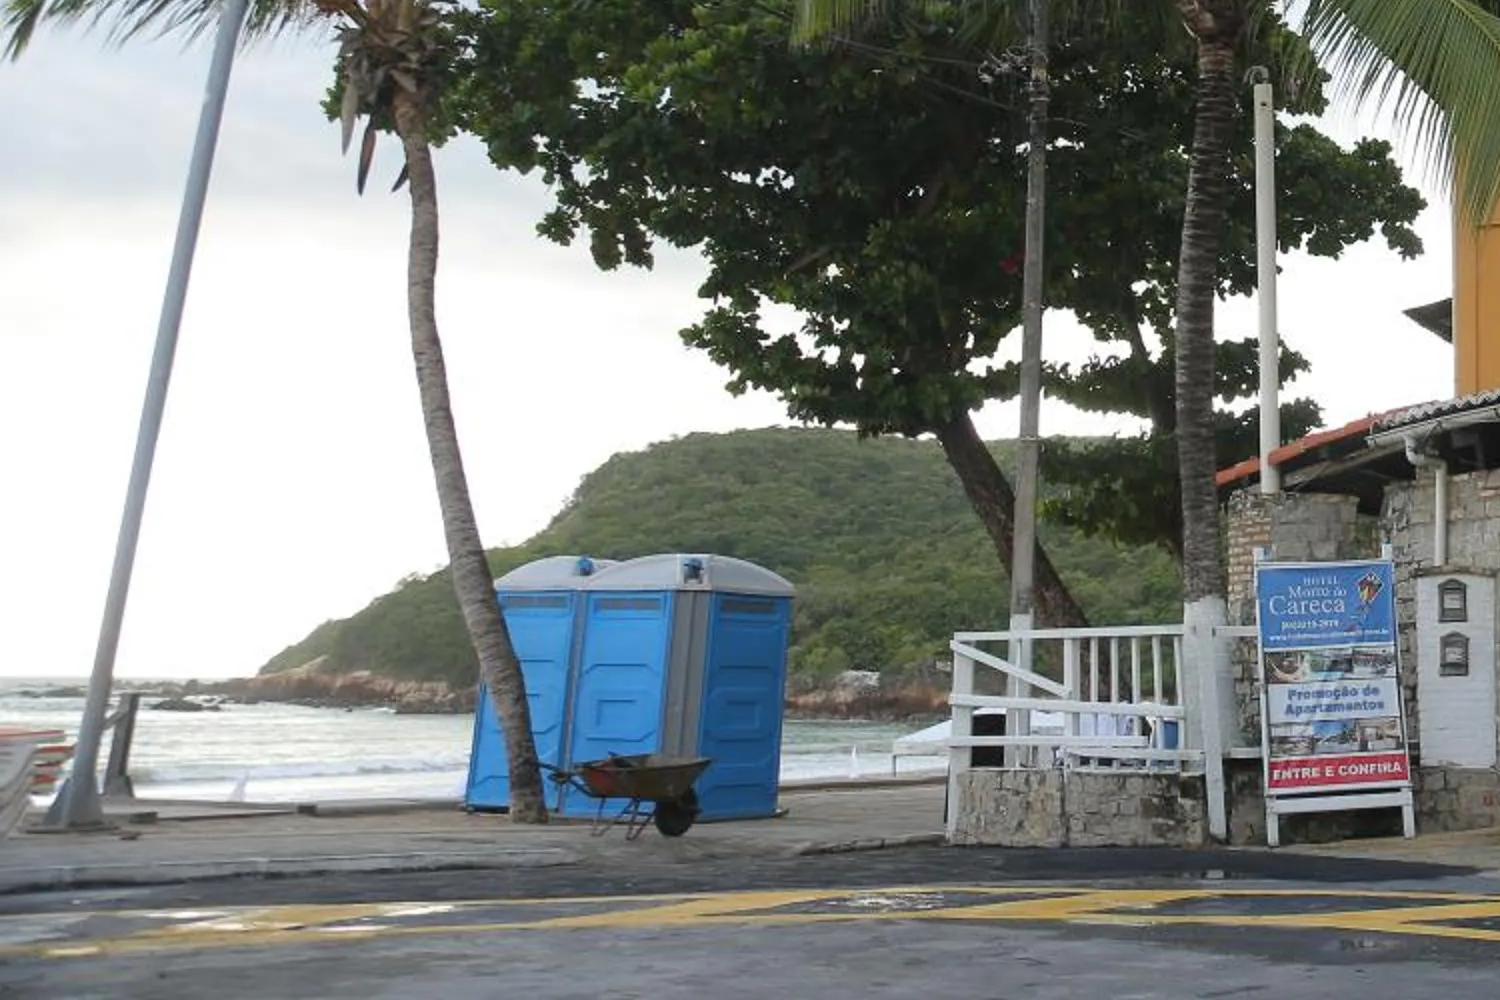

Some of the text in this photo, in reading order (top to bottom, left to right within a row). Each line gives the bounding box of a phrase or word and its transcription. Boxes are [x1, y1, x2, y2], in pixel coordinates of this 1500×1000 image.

[1288, 585, 1348, 599] Morro do
[1268, 594, 1346, 616] Careca
[1287, 684, 1381, 701] Promoção de
[1284, 700, 1386, 718] Apartamentos
[1272, 761, 1404, 781] ENTRE E CONFIRA
